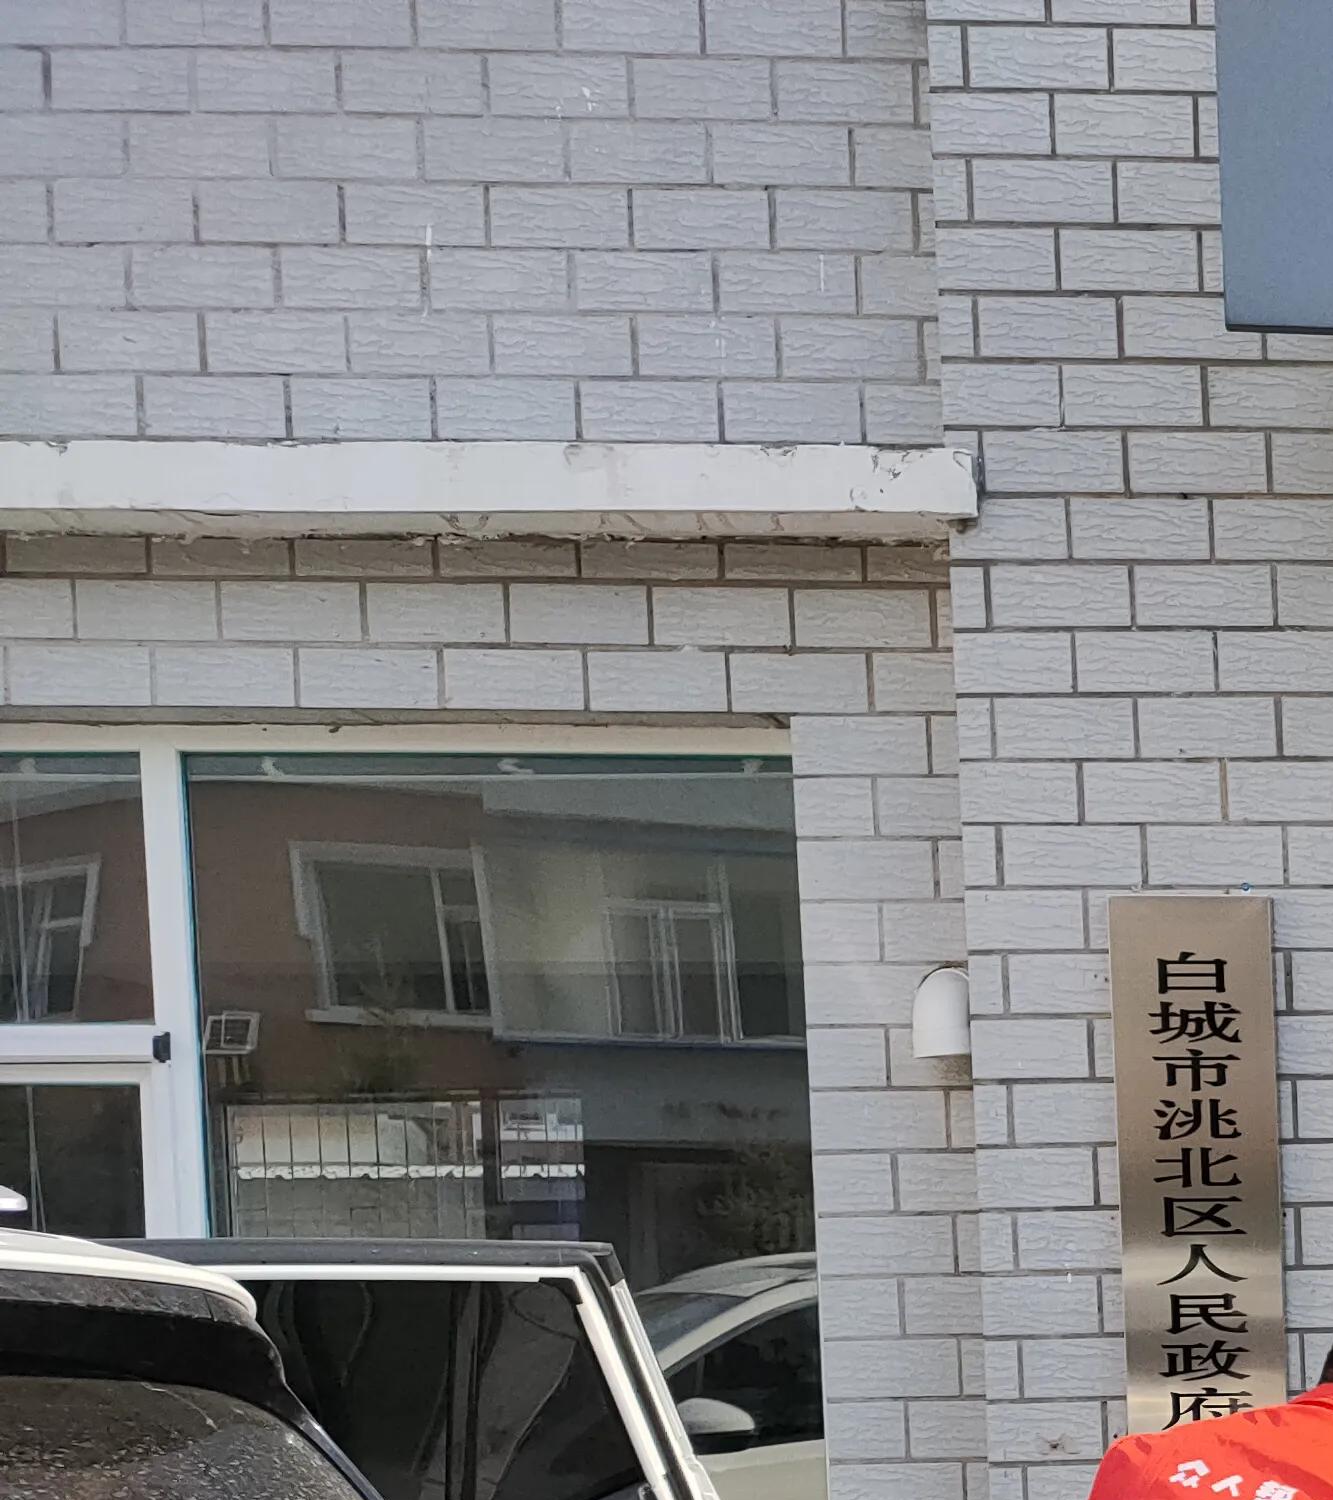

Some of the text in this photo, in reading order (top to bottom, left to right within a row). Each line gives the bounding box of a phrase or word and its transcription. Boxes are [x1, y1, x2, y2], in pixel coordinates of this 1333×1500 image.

[1148, 951, 1254, 1430] 白城市洮北区人民政府
